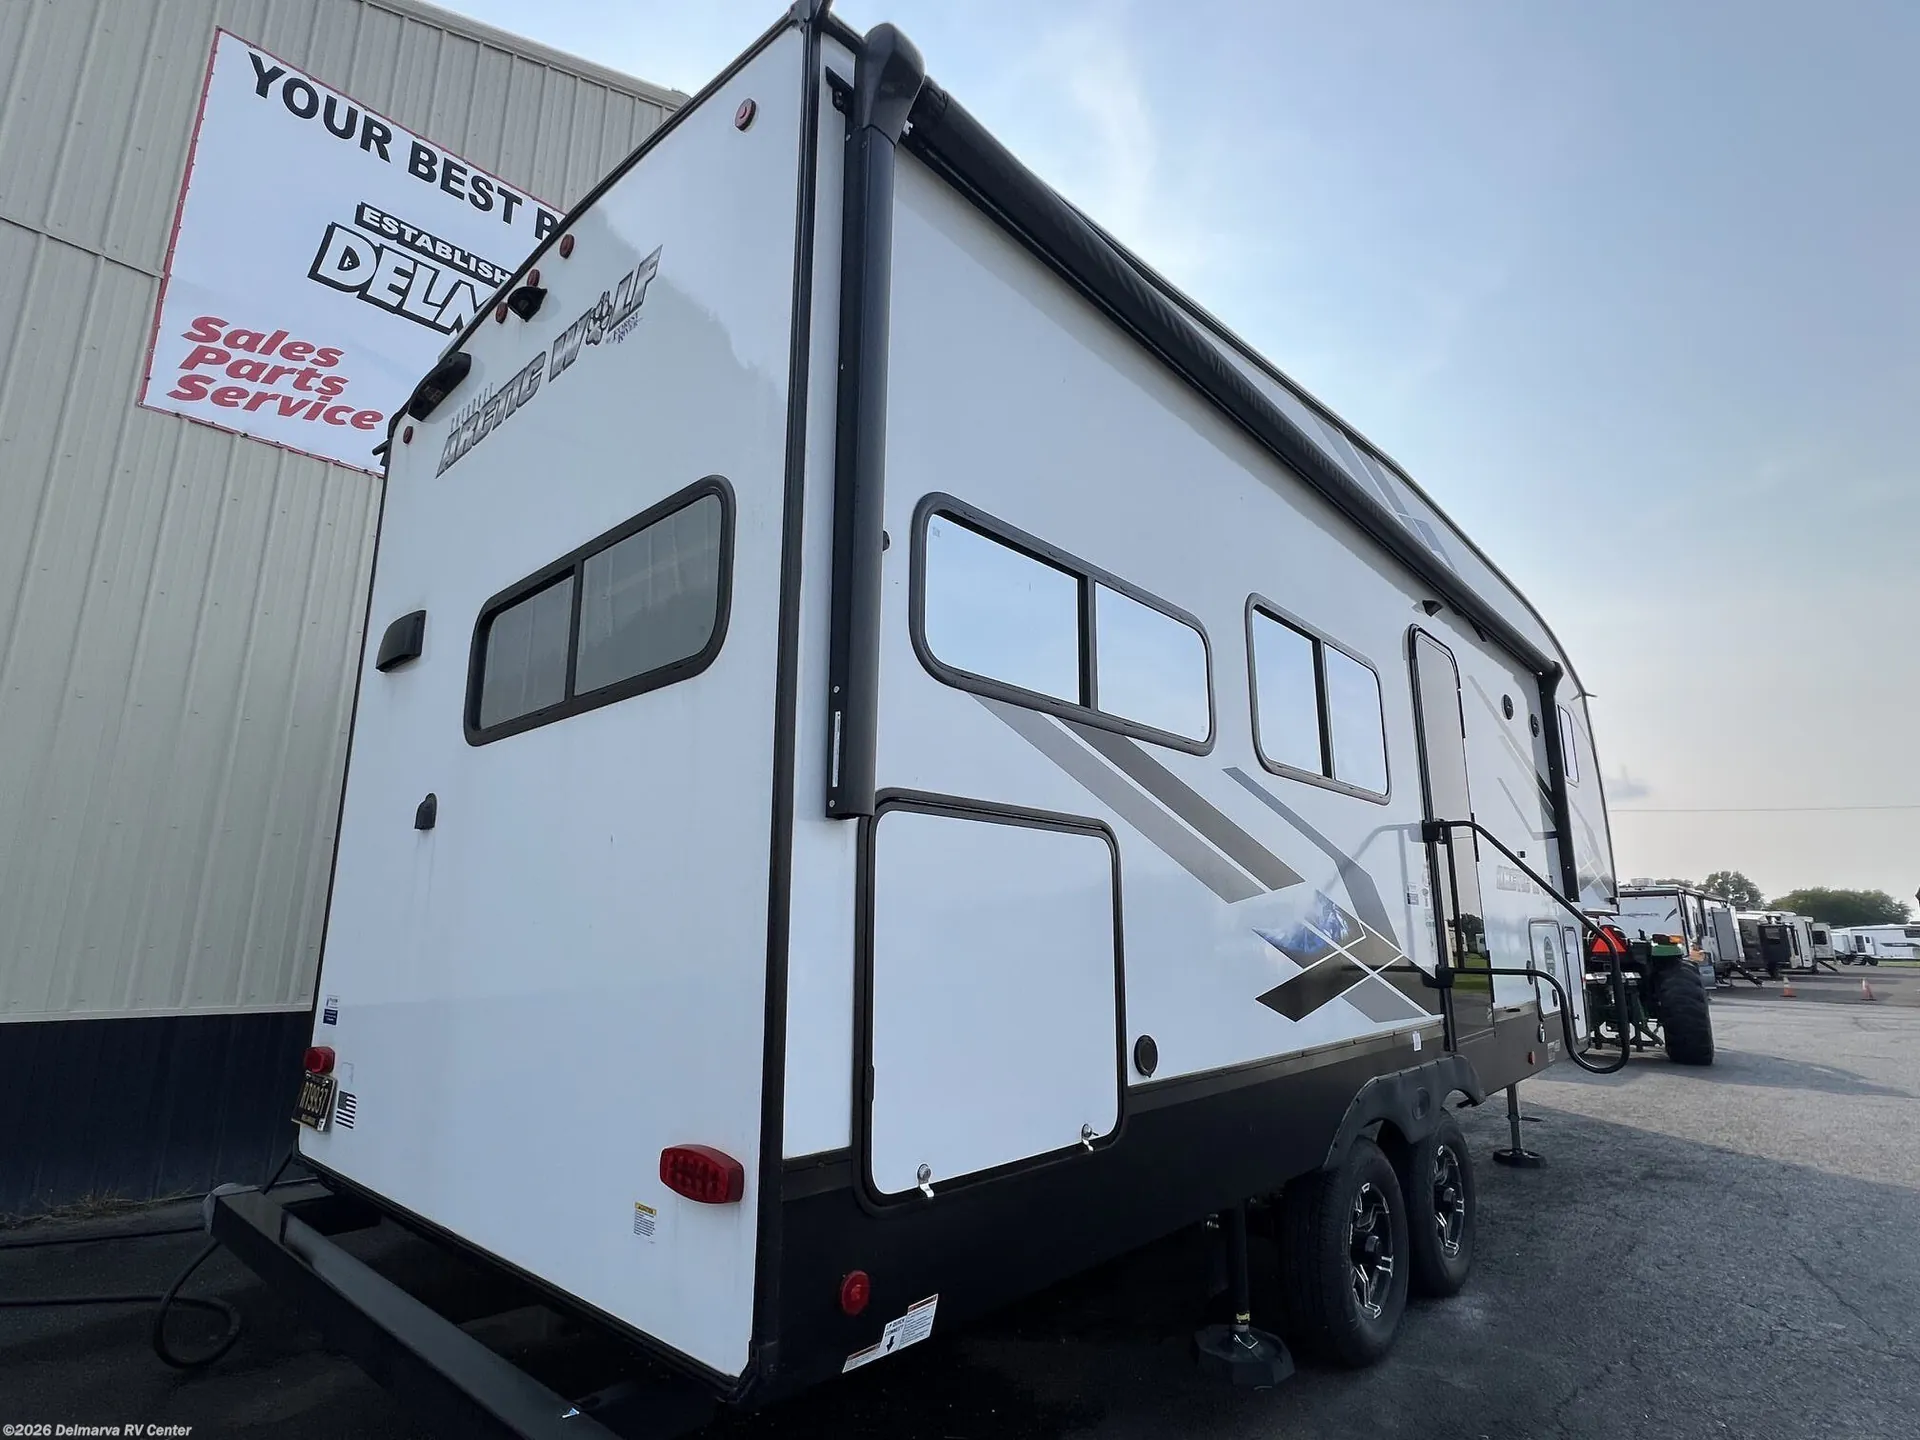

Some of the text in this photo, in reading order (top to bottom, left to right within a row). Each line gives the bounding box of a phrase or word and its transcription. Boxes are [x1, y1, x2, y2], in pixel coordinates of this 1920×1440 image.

[248, 51, 392, 164] YOUR
[407, 140, 523, 224] BEST
[181, 316, 345, 368] Sales
[178, 345, 349, 396] Parts
[166, 374, 384, 430] Service
[434, 350, 547, 479] ARCTIC
